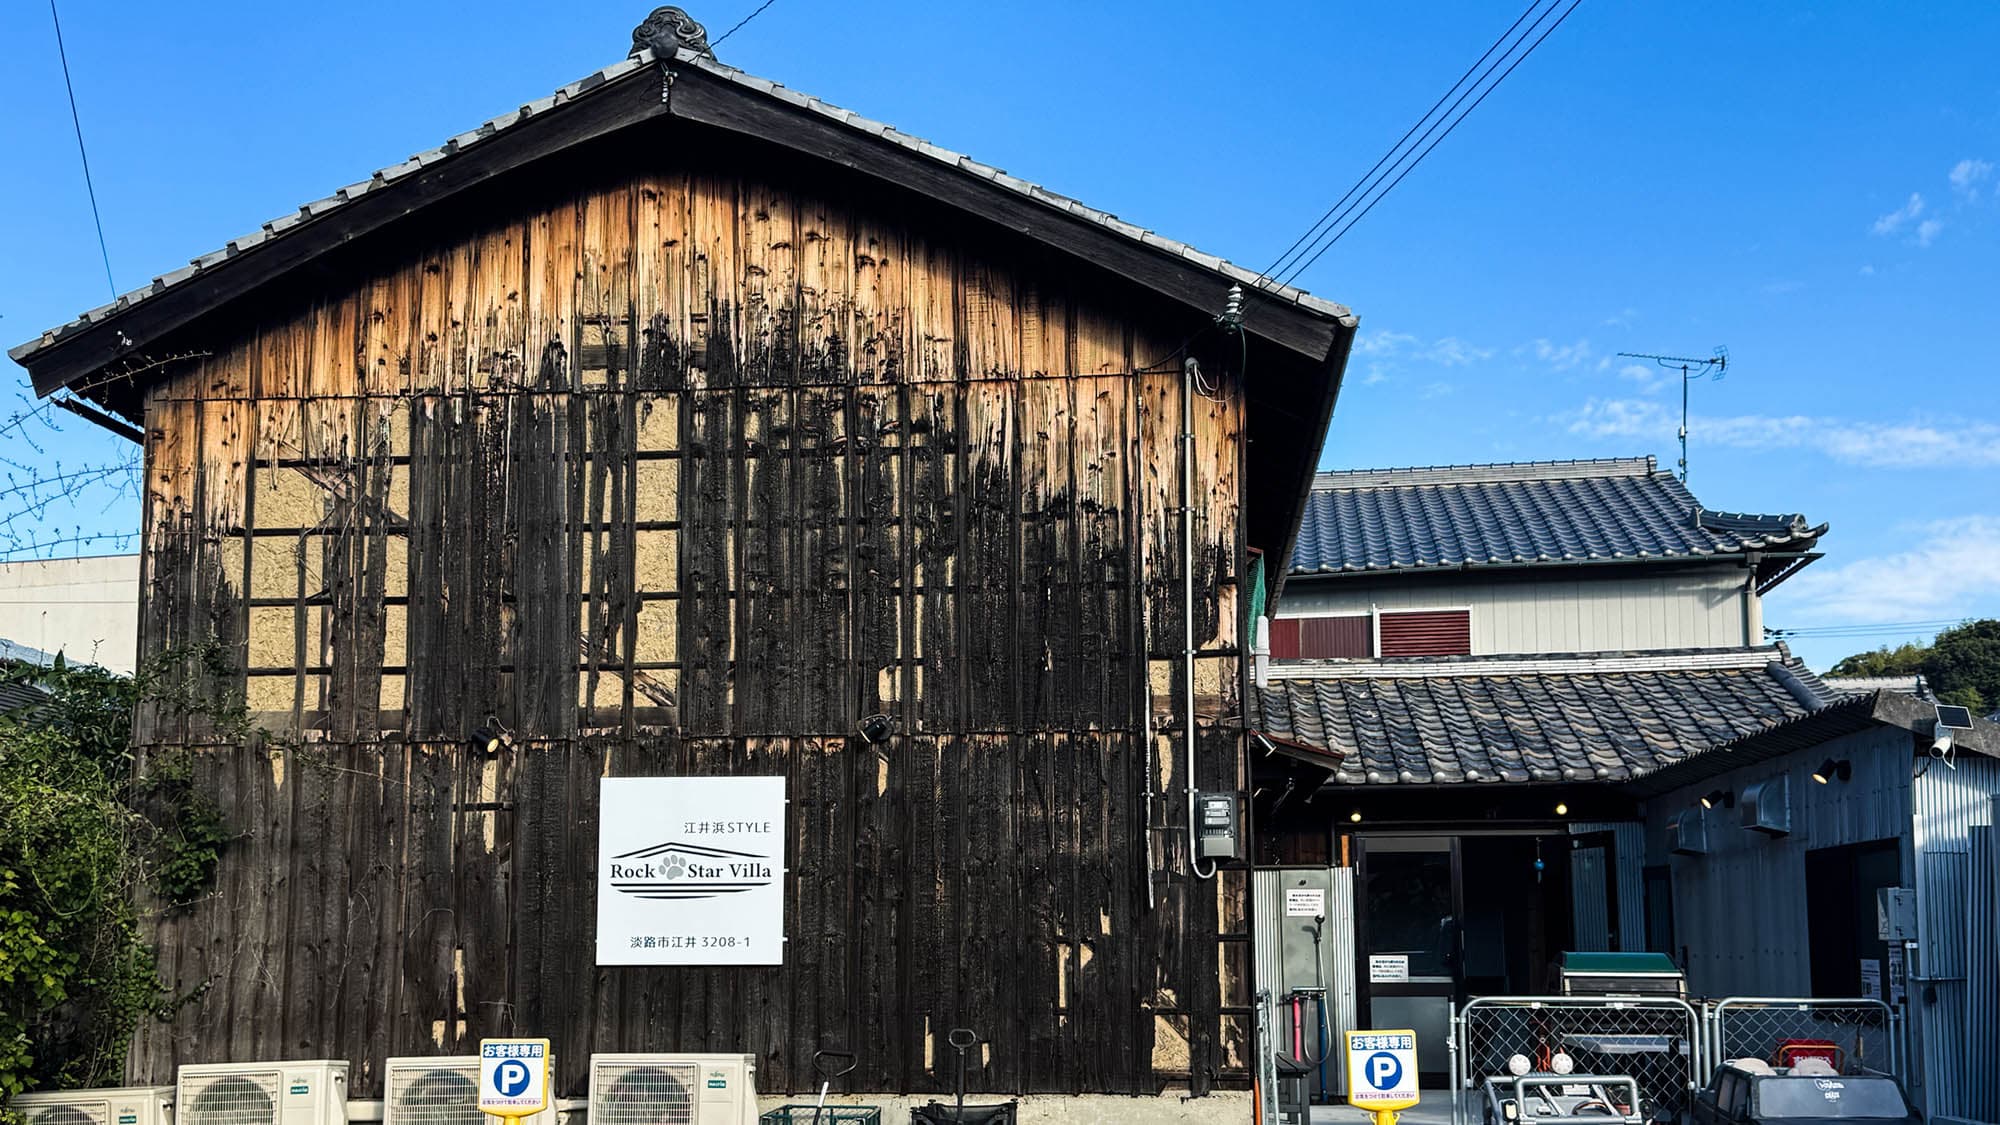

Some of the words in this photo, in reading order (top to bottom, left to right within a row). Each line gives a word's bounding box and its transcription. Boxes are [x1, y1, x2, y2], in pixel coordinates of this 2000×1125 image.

[684, 822, 771, 834] 江井浜STYLE
[610, 864, 656, 879] Rock
[688, 863, 724, 879] Star
[729, 863, 772, 879] Villa
[630, 936, 697, 948] 淡路市江井
[702, 936, 751, 948] 3208-1
[1352, 1036, 1412, 1049] お客様専用
[484, 1045, 543, 1057] お客様専用
[1372, 1056, 1397, 1087] P
[501, 1064, 525, 1094] P
